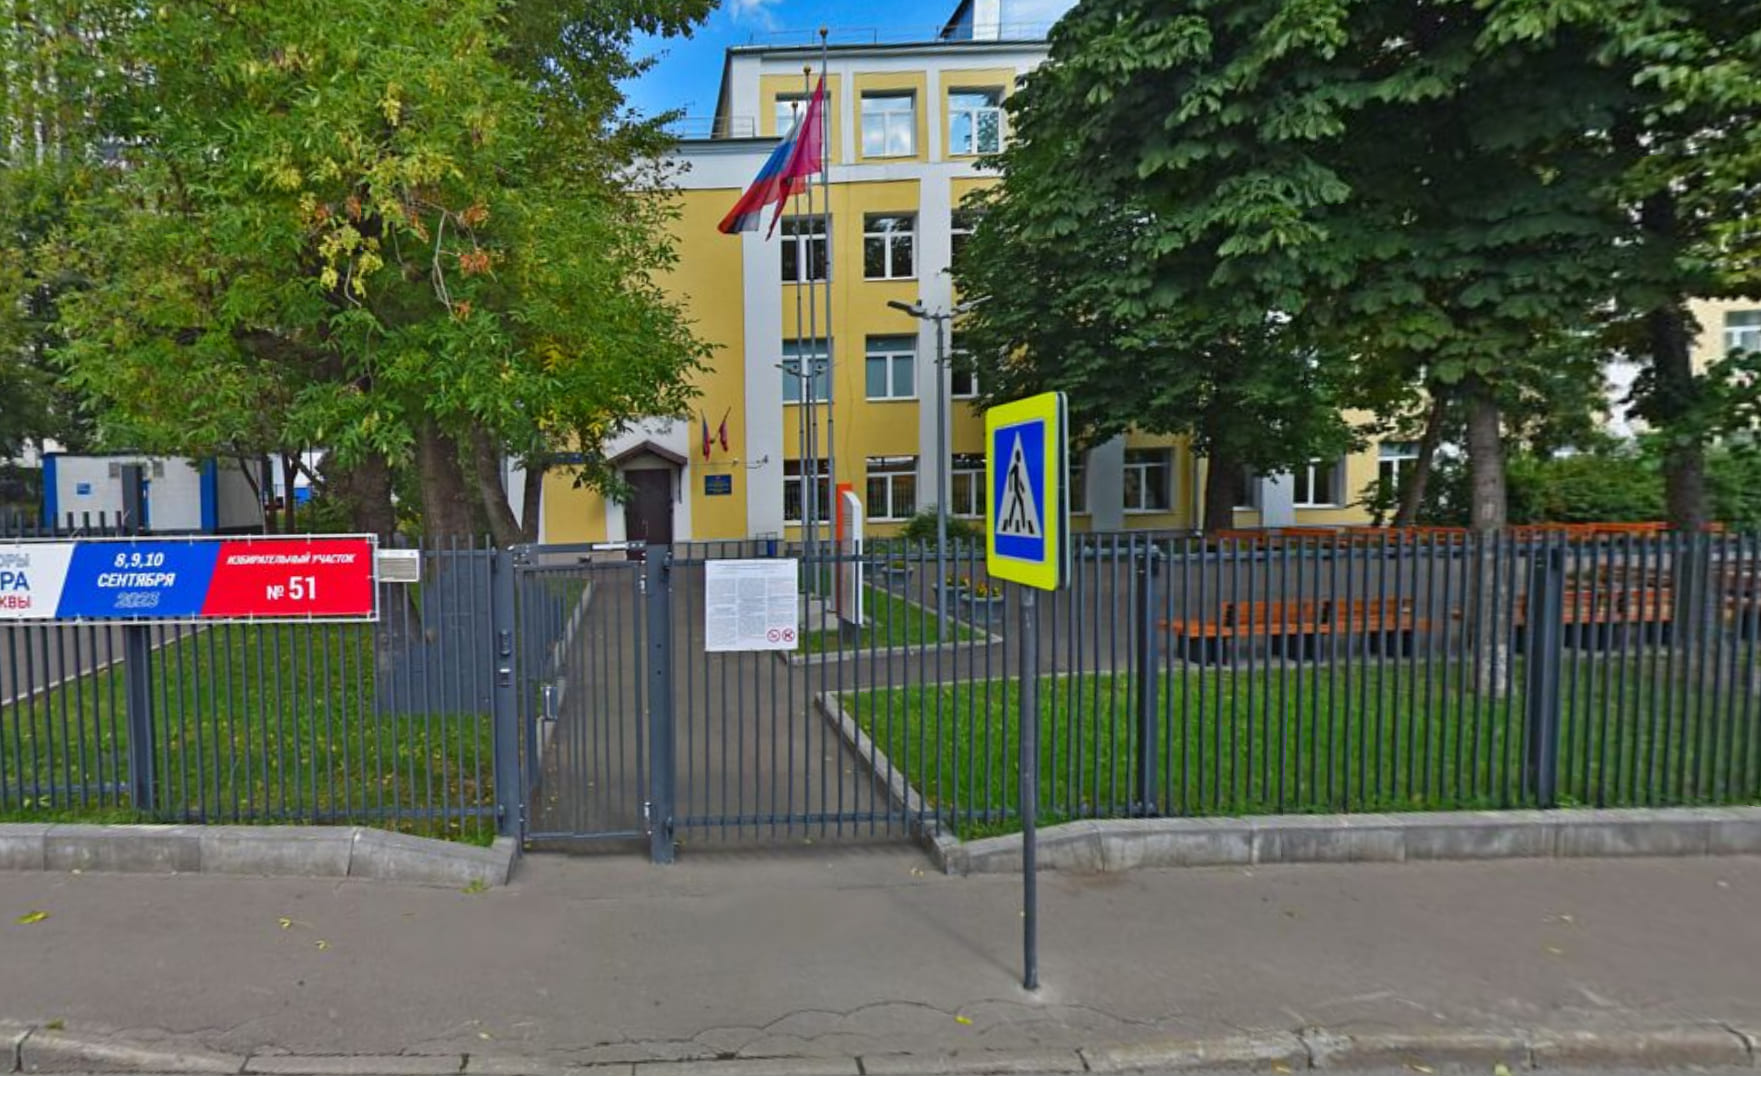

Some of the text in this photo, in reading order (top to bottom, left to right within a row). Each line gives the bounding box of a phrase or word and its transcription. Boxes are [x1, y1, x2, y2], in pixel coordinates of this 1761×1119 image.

[114, 552, 164, 569] 8,9,10
[226, 552, 356, 565] ИЗБИРАТЕЛЬНЫЙ УЧАСТОК
[97, 573, 176, 587] СЕНТЯБРЯ
[289, 576, 316, 600] 51
